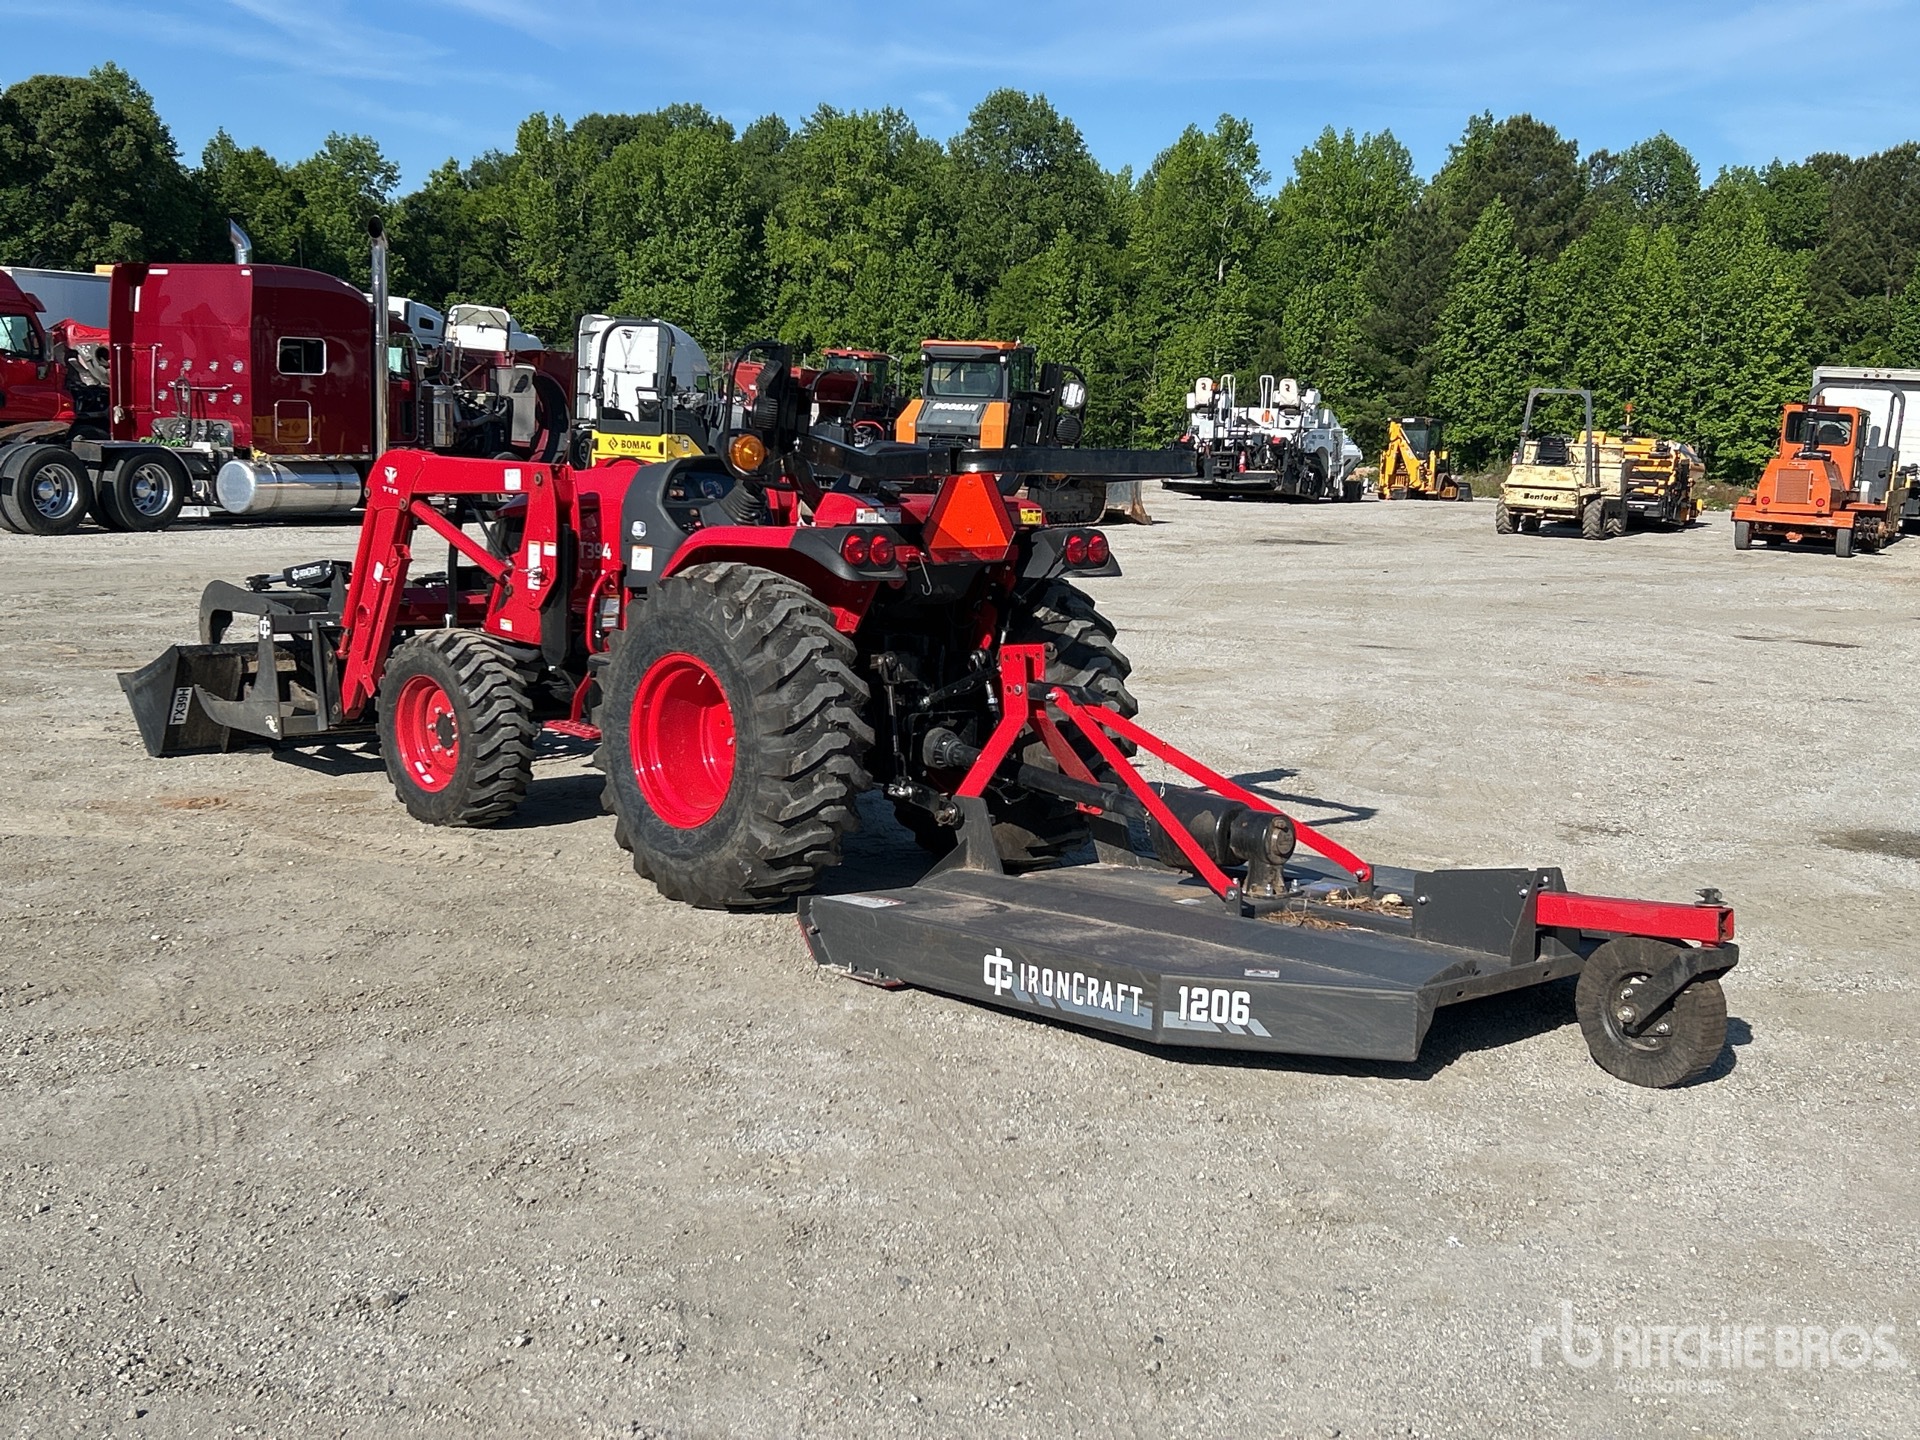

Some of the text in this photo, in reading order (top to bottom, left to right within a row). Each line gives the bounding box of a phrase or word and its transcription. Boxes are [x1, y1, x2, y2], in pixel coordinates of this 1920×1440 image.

[620, 439, 652, 450] BOMAG
[1523, 492, 1559, 501] Benford
[579, 541, 613, 560] T394
[172, 688, 190, 723] TX39H
[1019, 962, 1143, 1016] IRONCRAFT
[1177, 985, 1251, 1027] 1206
